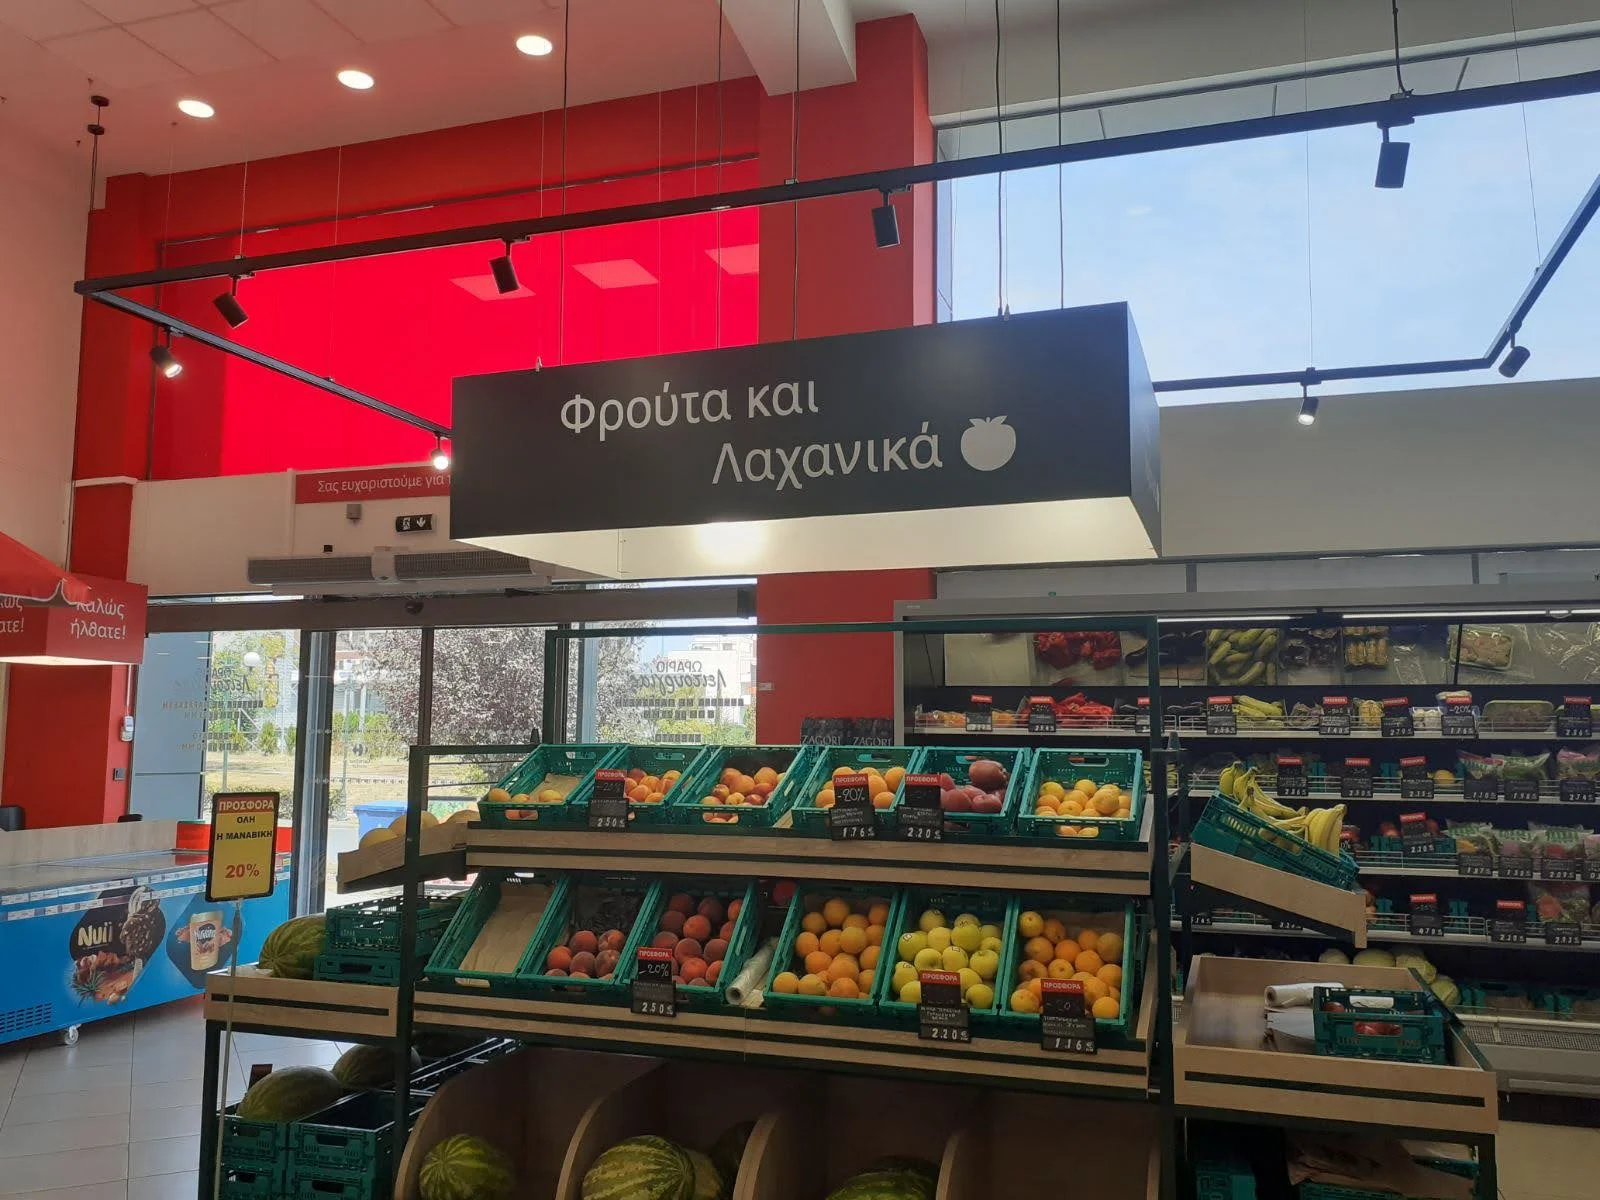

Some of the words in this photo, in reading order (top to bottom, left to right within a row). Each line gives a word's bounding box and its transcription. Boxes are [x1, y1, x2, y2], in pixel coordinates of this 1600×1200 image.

[560, 381, 731, 441] Φρούτα
[748, 380, 819, 418] και
[711, 421, 943, 491] Λαχανικά
[318, 480, 339, 494] Σας
[341, 474, 424, 493] ευχαριστούμε
[425, 474, 445, 488] για
[0, 617, 25, 633] ατε!
[70, 618, 126, 640] ήλθατε!
[801, 735, 841, 746] ZAGORI
[853, 736, 892, 747] ZAGORI
[906, 775, 938, 783] ΠΡΟΣΦΟΡΑ
[219, 799, 274, 811] ΠΡΟΣΦΟΡΑ
[236, 815, 256, 824] ΟΛΗ
[216, 832, 223, 840] Η
[225, 830, 273, 840] ΜΑΝΑΒΙΚΗ
[224, 863, 260, 879] 20%
[639, 950, 670, 958] ΠΡΟΣΦΟΡΑ
[638, 963, 670, 977] -20%
[922, 973, 958, 982] ΠΡΟΣΦΟΡΑ
[1043, 981, 1081, 990] ΠΡΟΣΦΟΡΑ
